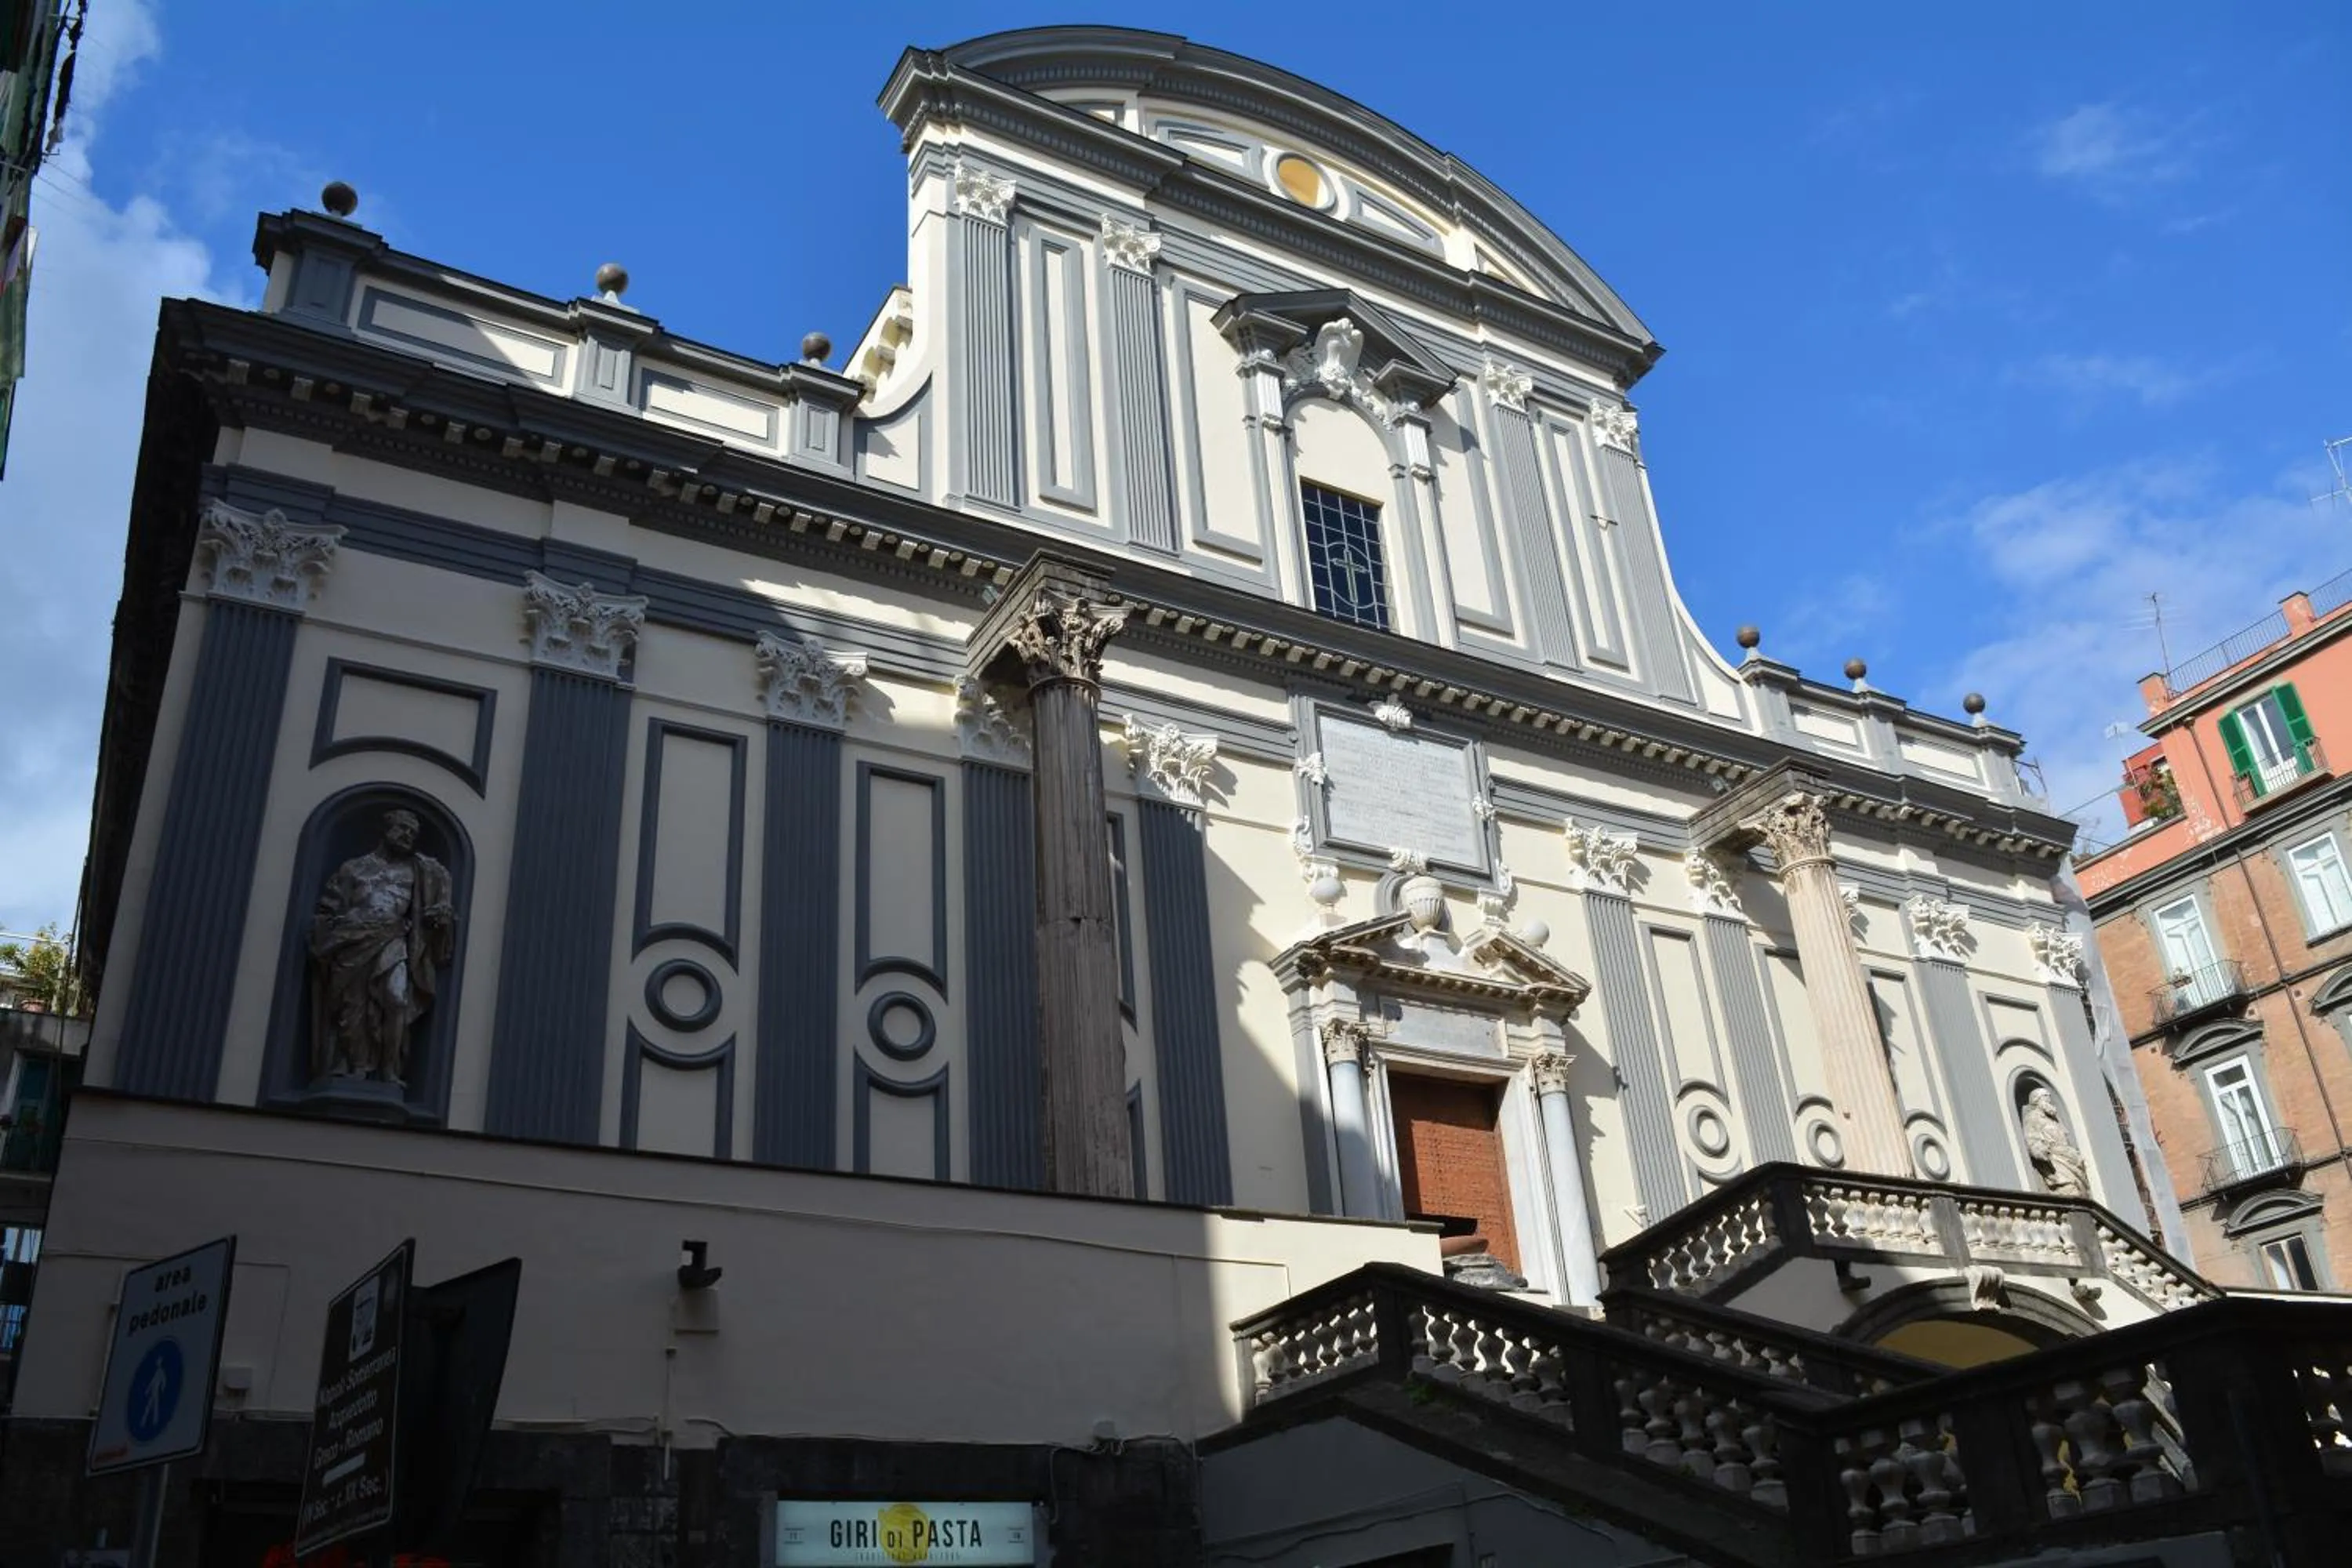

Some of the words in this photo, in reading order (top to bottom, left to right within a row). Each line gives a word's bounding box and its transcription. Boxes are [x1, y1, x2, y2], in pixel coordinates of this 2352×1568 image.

[154, 1265, 191, 1292] area
[128, 1290, 207, 1338] pedonale
[830, 1519, 877, 1548] GIRI
[887, 1531, 902, 1548] DI
[913, 1519, 982, 1548] PASTA
